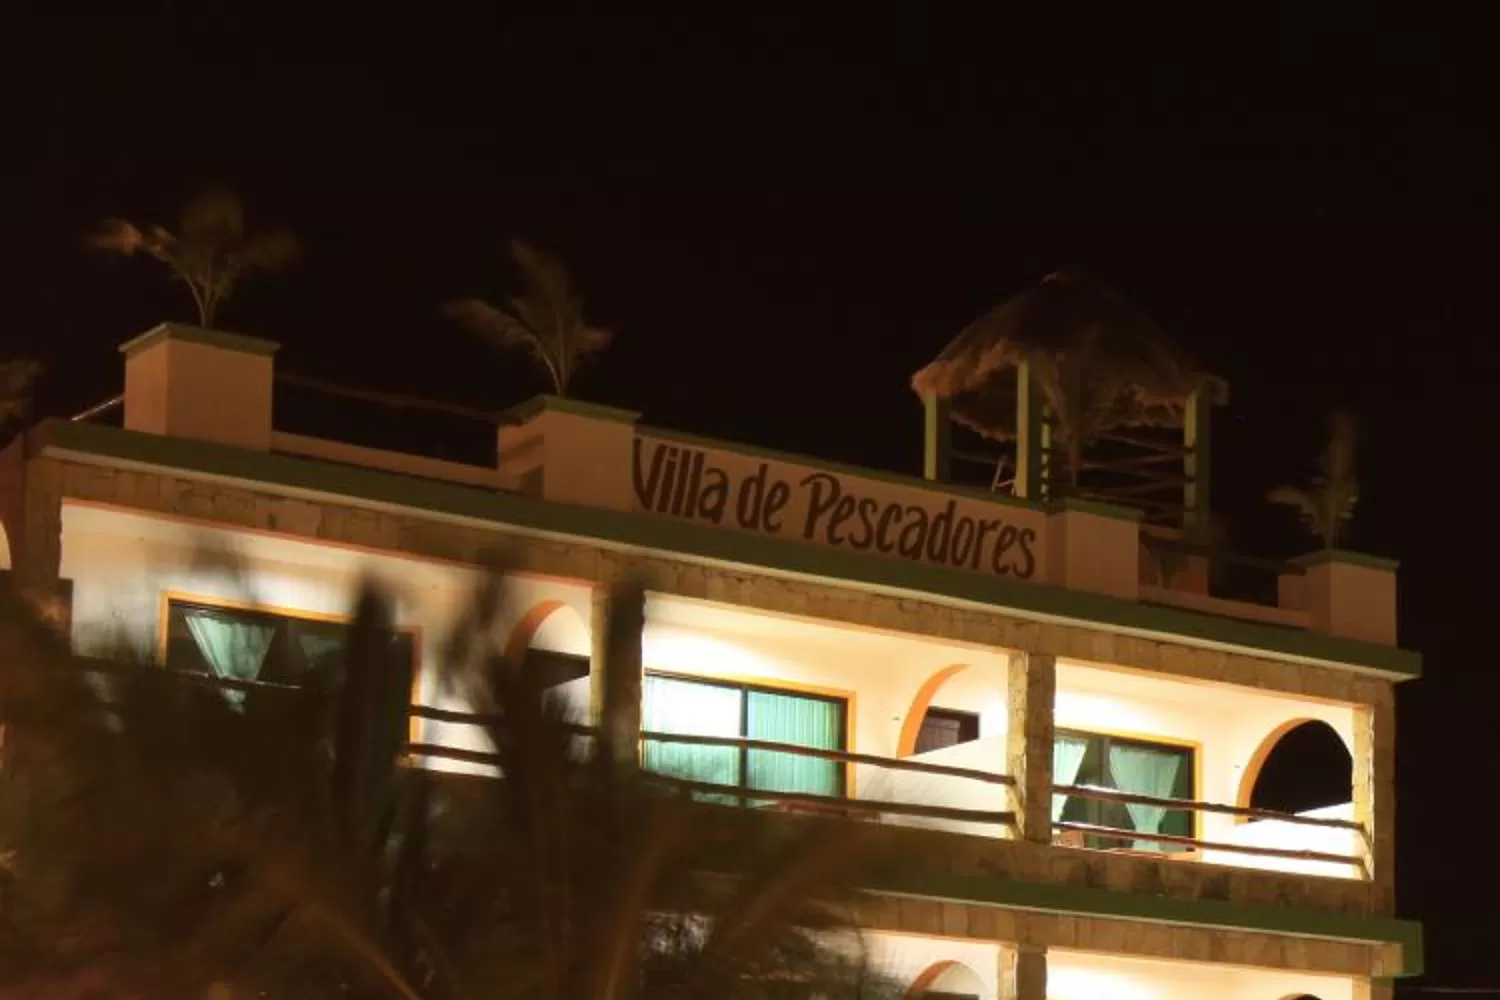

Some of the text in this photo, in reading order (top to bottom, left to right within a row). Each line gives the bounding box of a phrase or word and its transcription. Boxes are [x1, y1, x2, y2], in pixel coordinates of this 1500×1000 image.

[632, 437, 1036, 579] Villa de Pescadores
